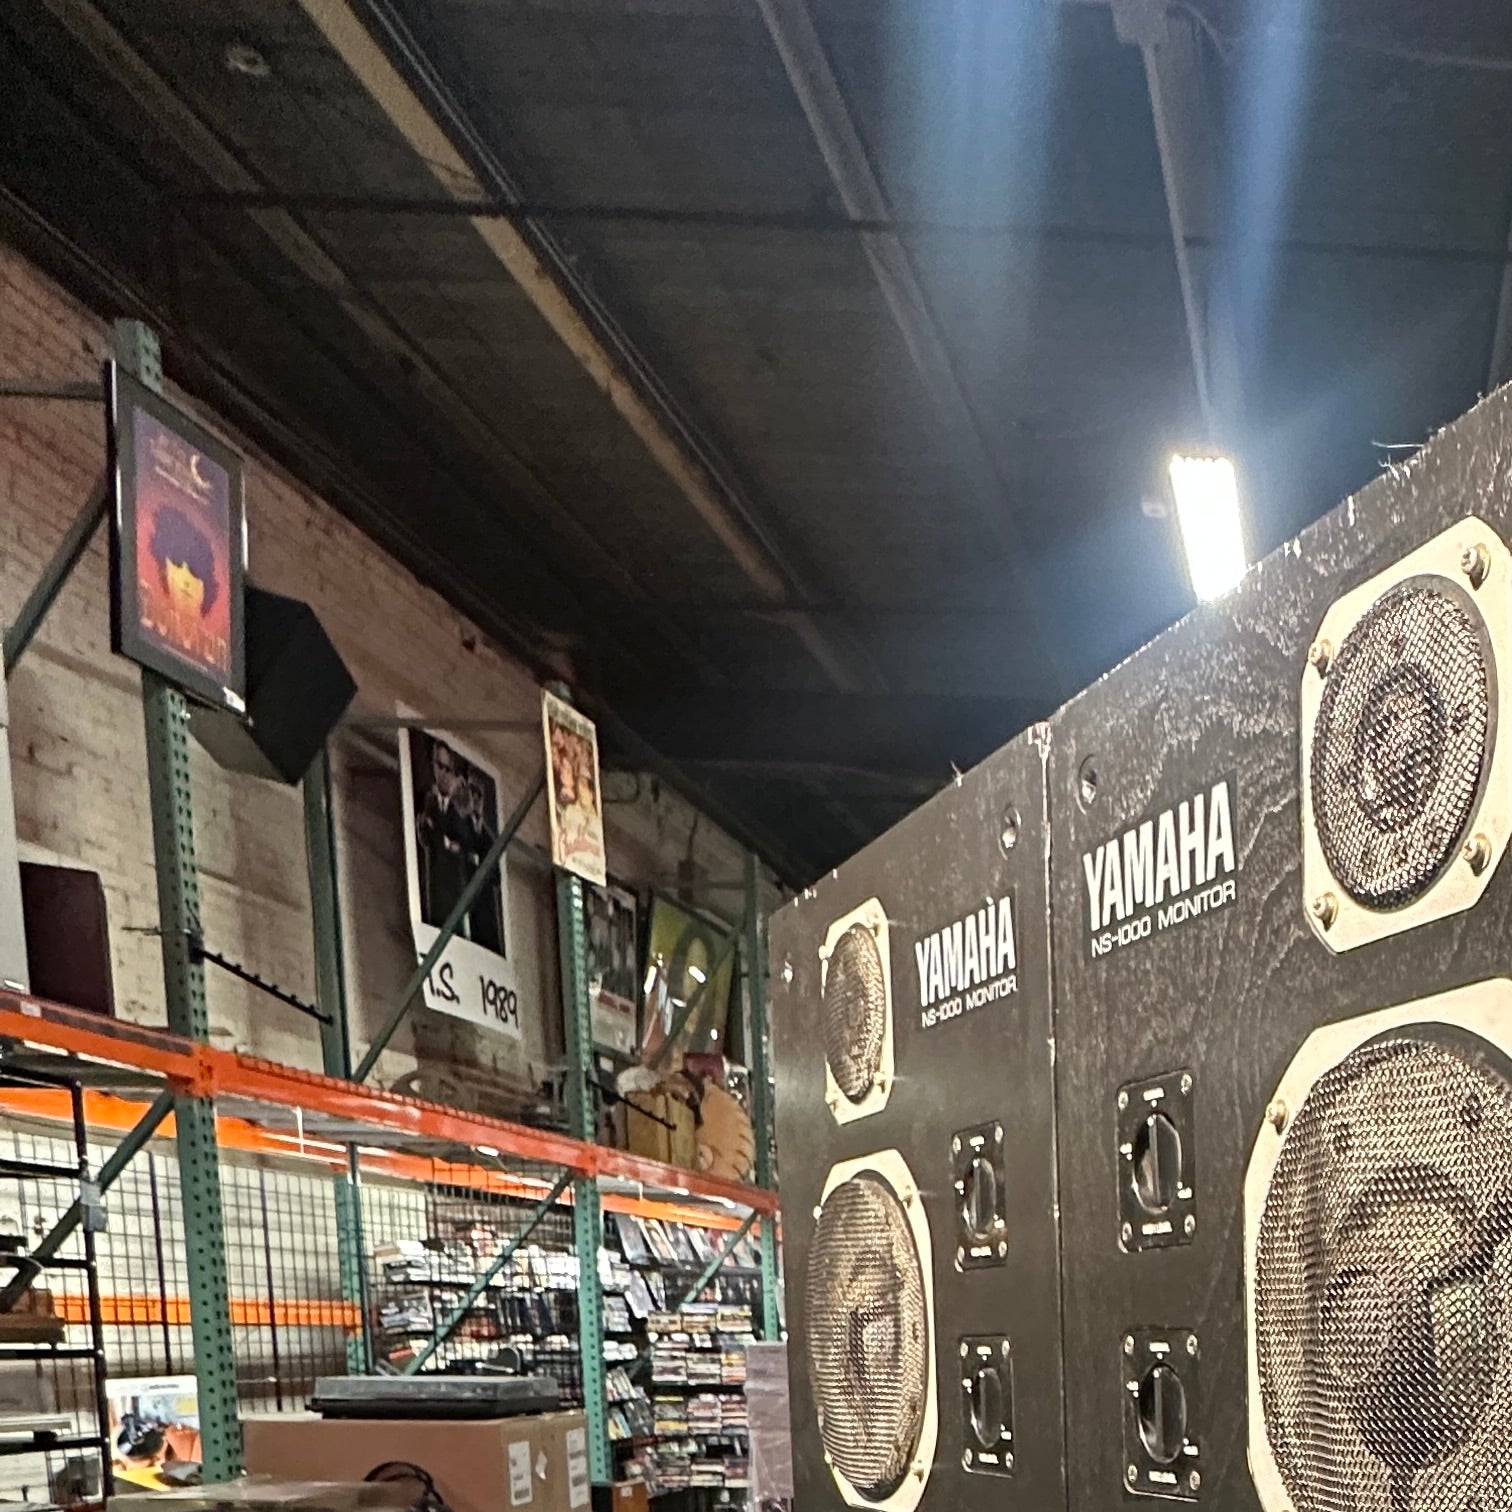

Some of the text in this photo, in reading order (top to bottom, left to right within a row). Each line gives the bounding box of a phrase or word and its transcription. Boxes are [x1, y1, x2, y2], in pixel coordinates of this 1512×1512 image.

[1083, 781, 1236, 932] YAMAHA
[915, 896, 1016, 1007] YAMAHA
[1091, 879, 1236, 958] NS-1000 MONITOR
[479, 975, 519, 1029] 1989
[921, 974, 1018, 1028] NS-1000 MONITOR
